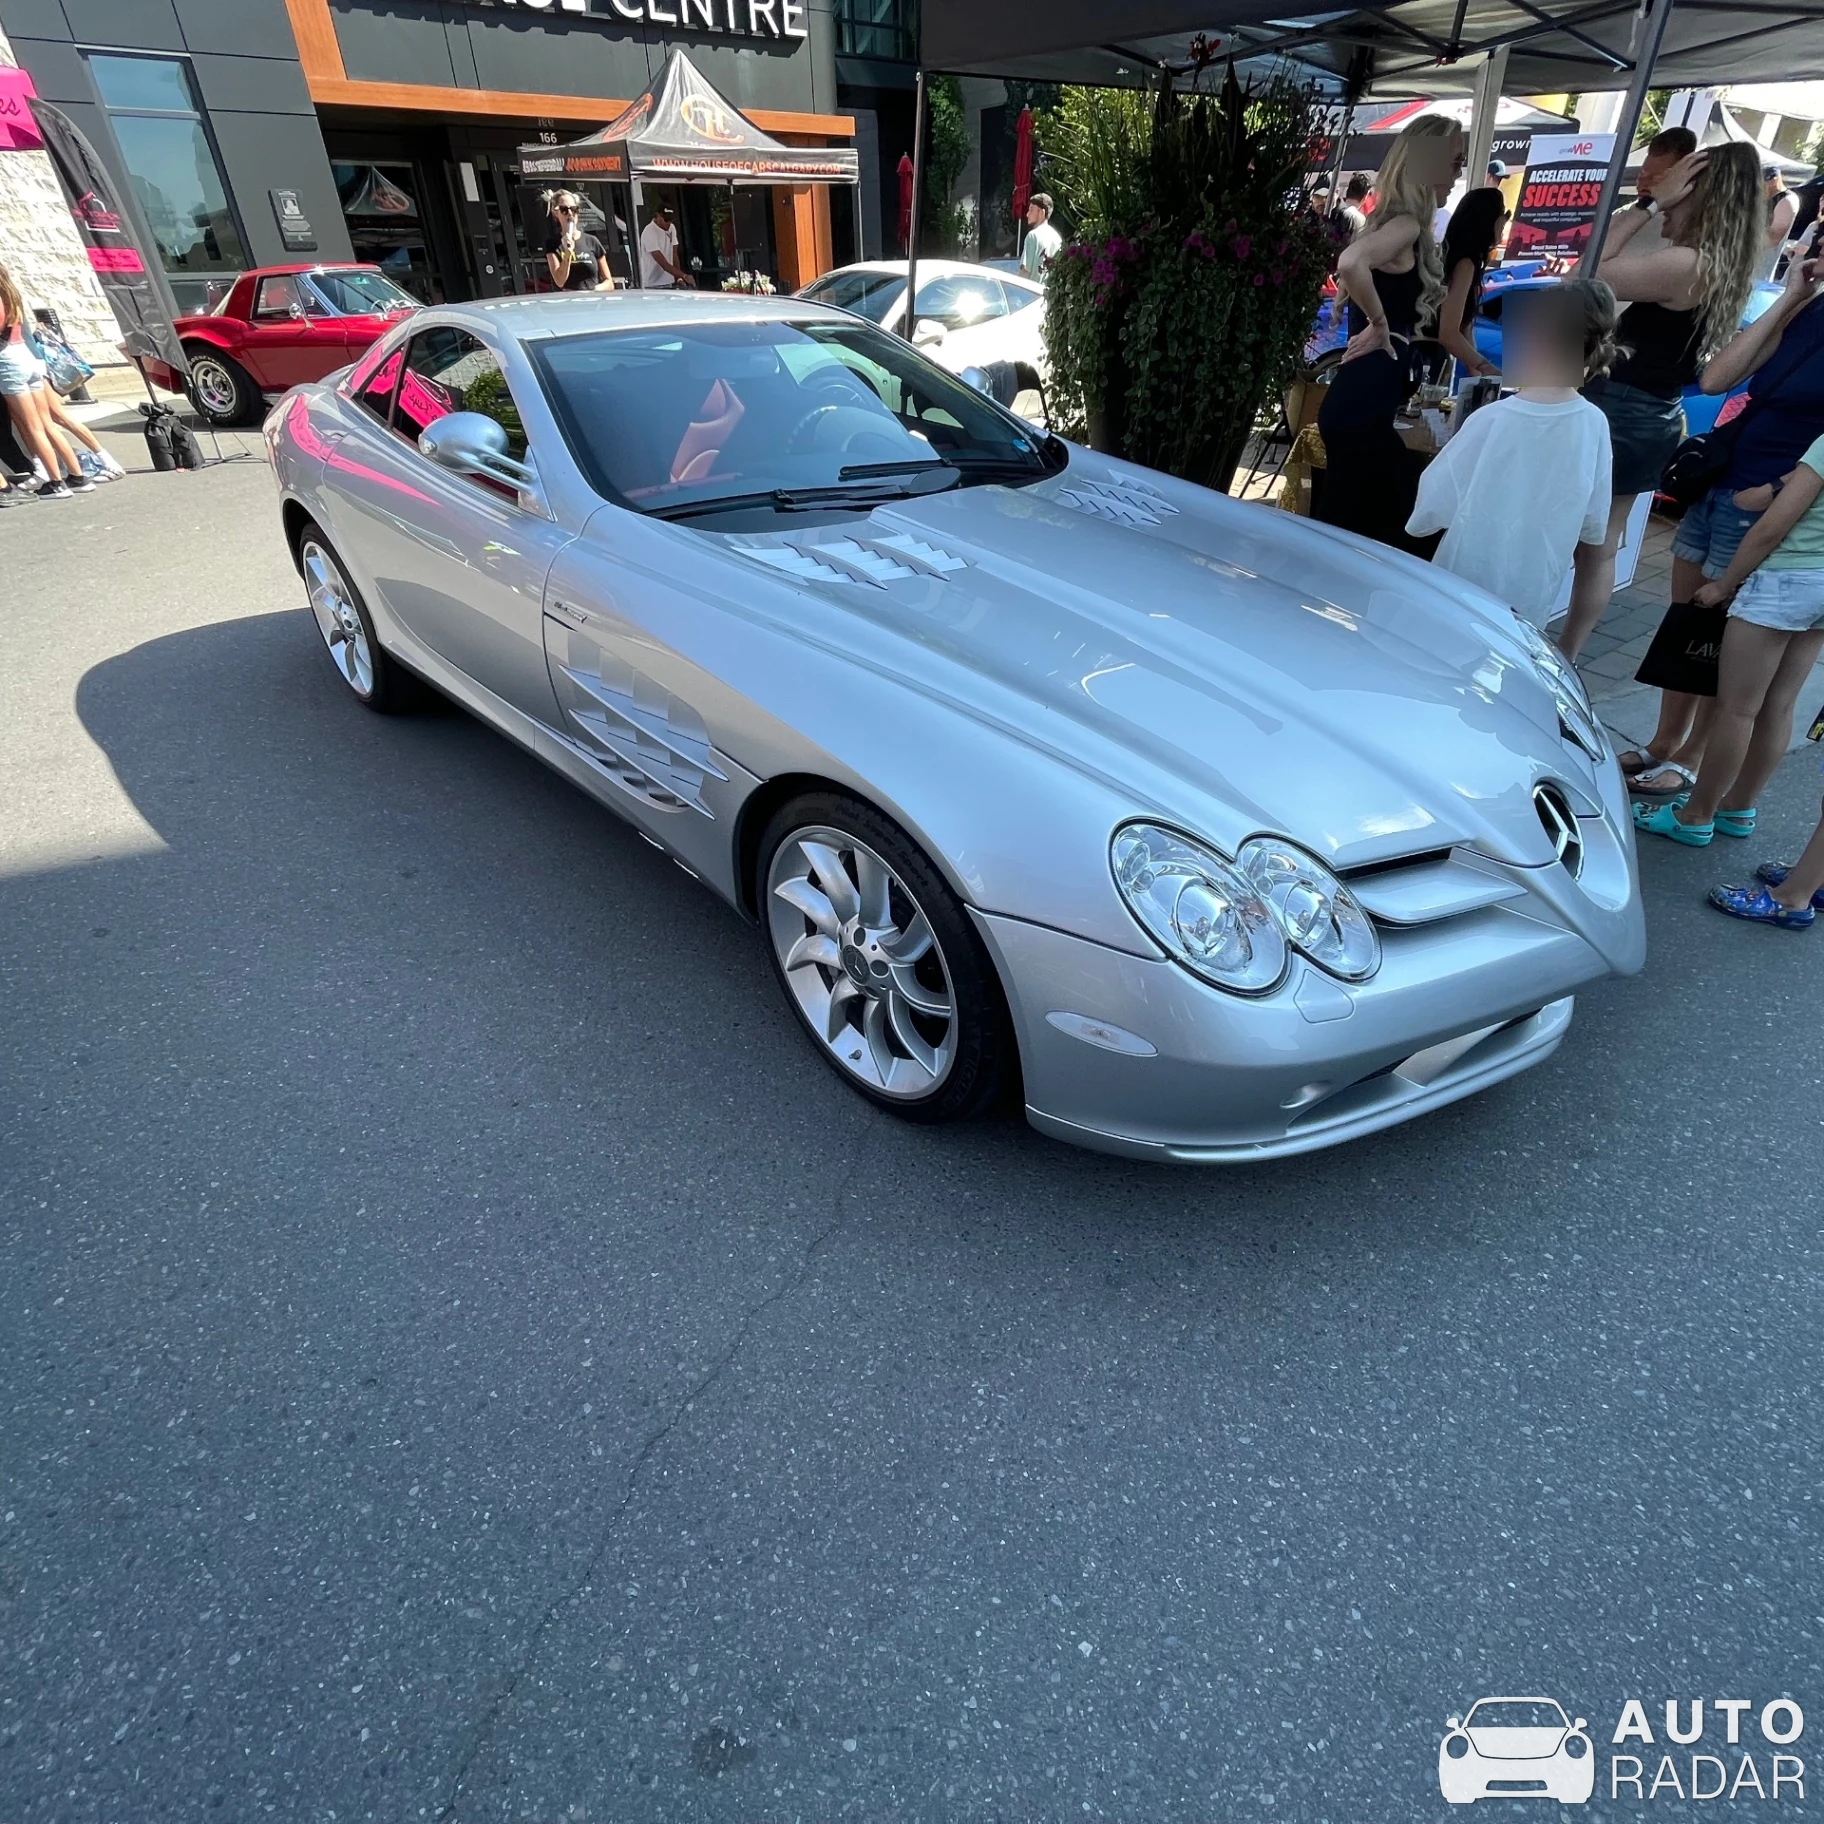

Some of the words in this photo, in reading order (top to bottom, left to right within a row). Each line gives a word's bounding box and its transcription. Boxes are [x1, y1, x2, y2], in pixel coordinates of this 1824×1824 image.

[539, 132, 557, 144] 166
[1529, 169, 1585, 183] ACCELERATE
[1523, 183, 1601, 208] SUCCESS
